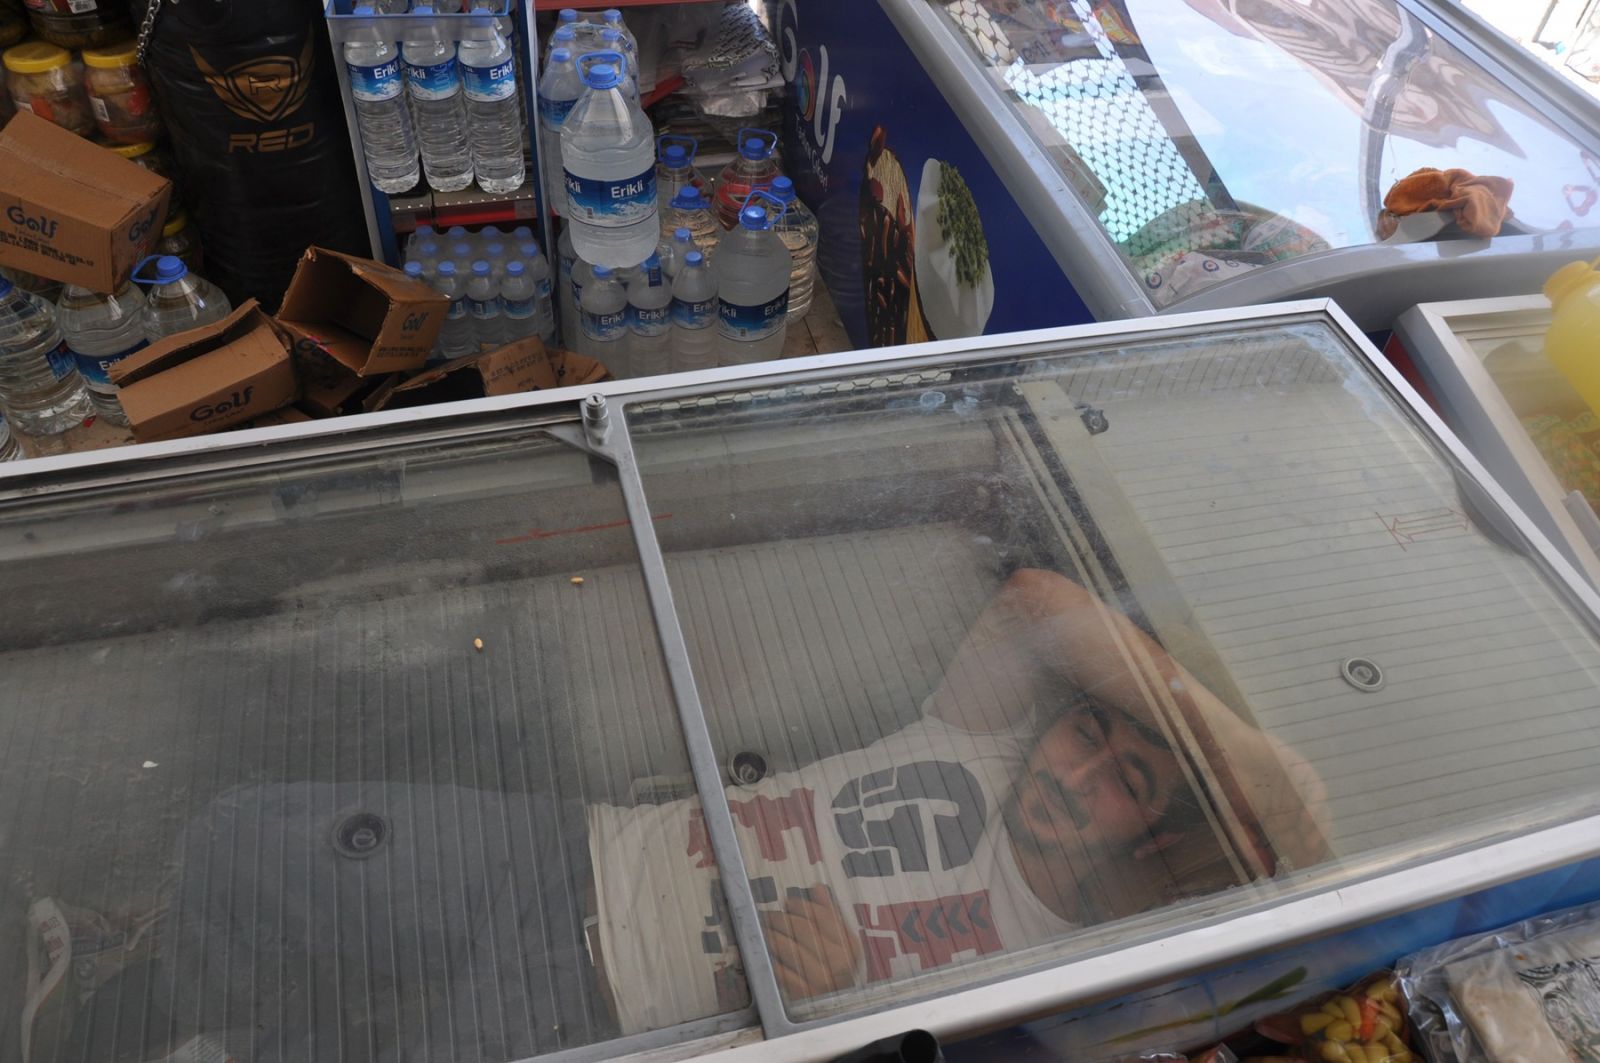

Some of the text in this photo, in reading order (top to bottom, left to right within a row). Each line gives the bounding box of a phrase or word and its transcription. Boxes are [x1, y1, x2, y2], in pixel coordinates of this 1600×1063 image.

[228, 122, 314, 153] RED
[611, 181, 644, 199] Erikli
[6, 205, 59, 239] Golf
[190, 386, 254, 423] Golf
